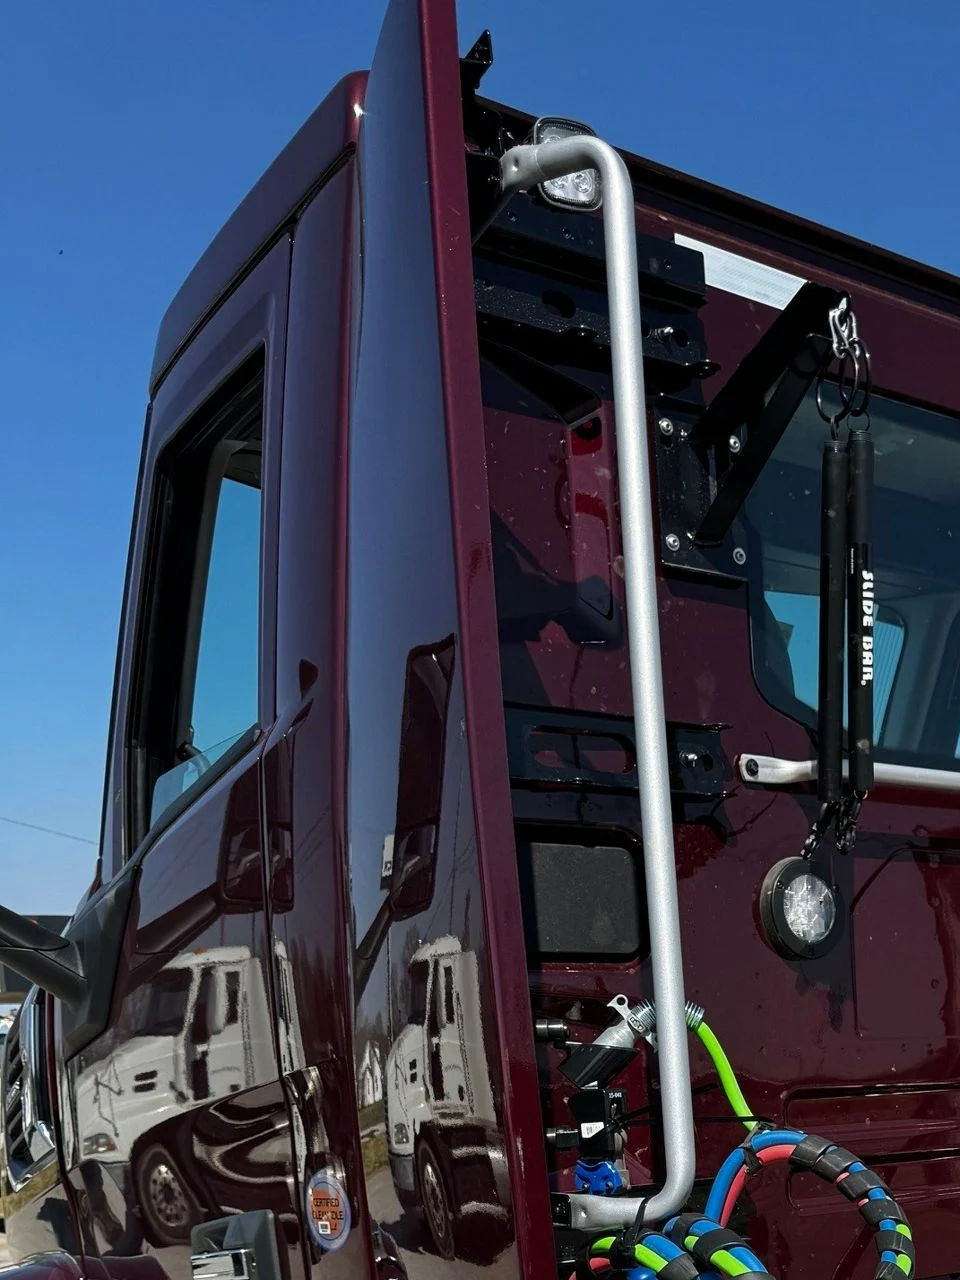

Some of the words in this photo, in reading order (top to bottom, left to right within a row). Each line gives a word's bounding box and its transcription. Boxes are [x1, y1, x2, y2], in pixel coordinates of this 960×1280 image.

[862, 570, 875, 627] SLIDE
[313, 1197, 340, 1208] CERTIFIED
[328, 1210, 344, 1220] DLE
